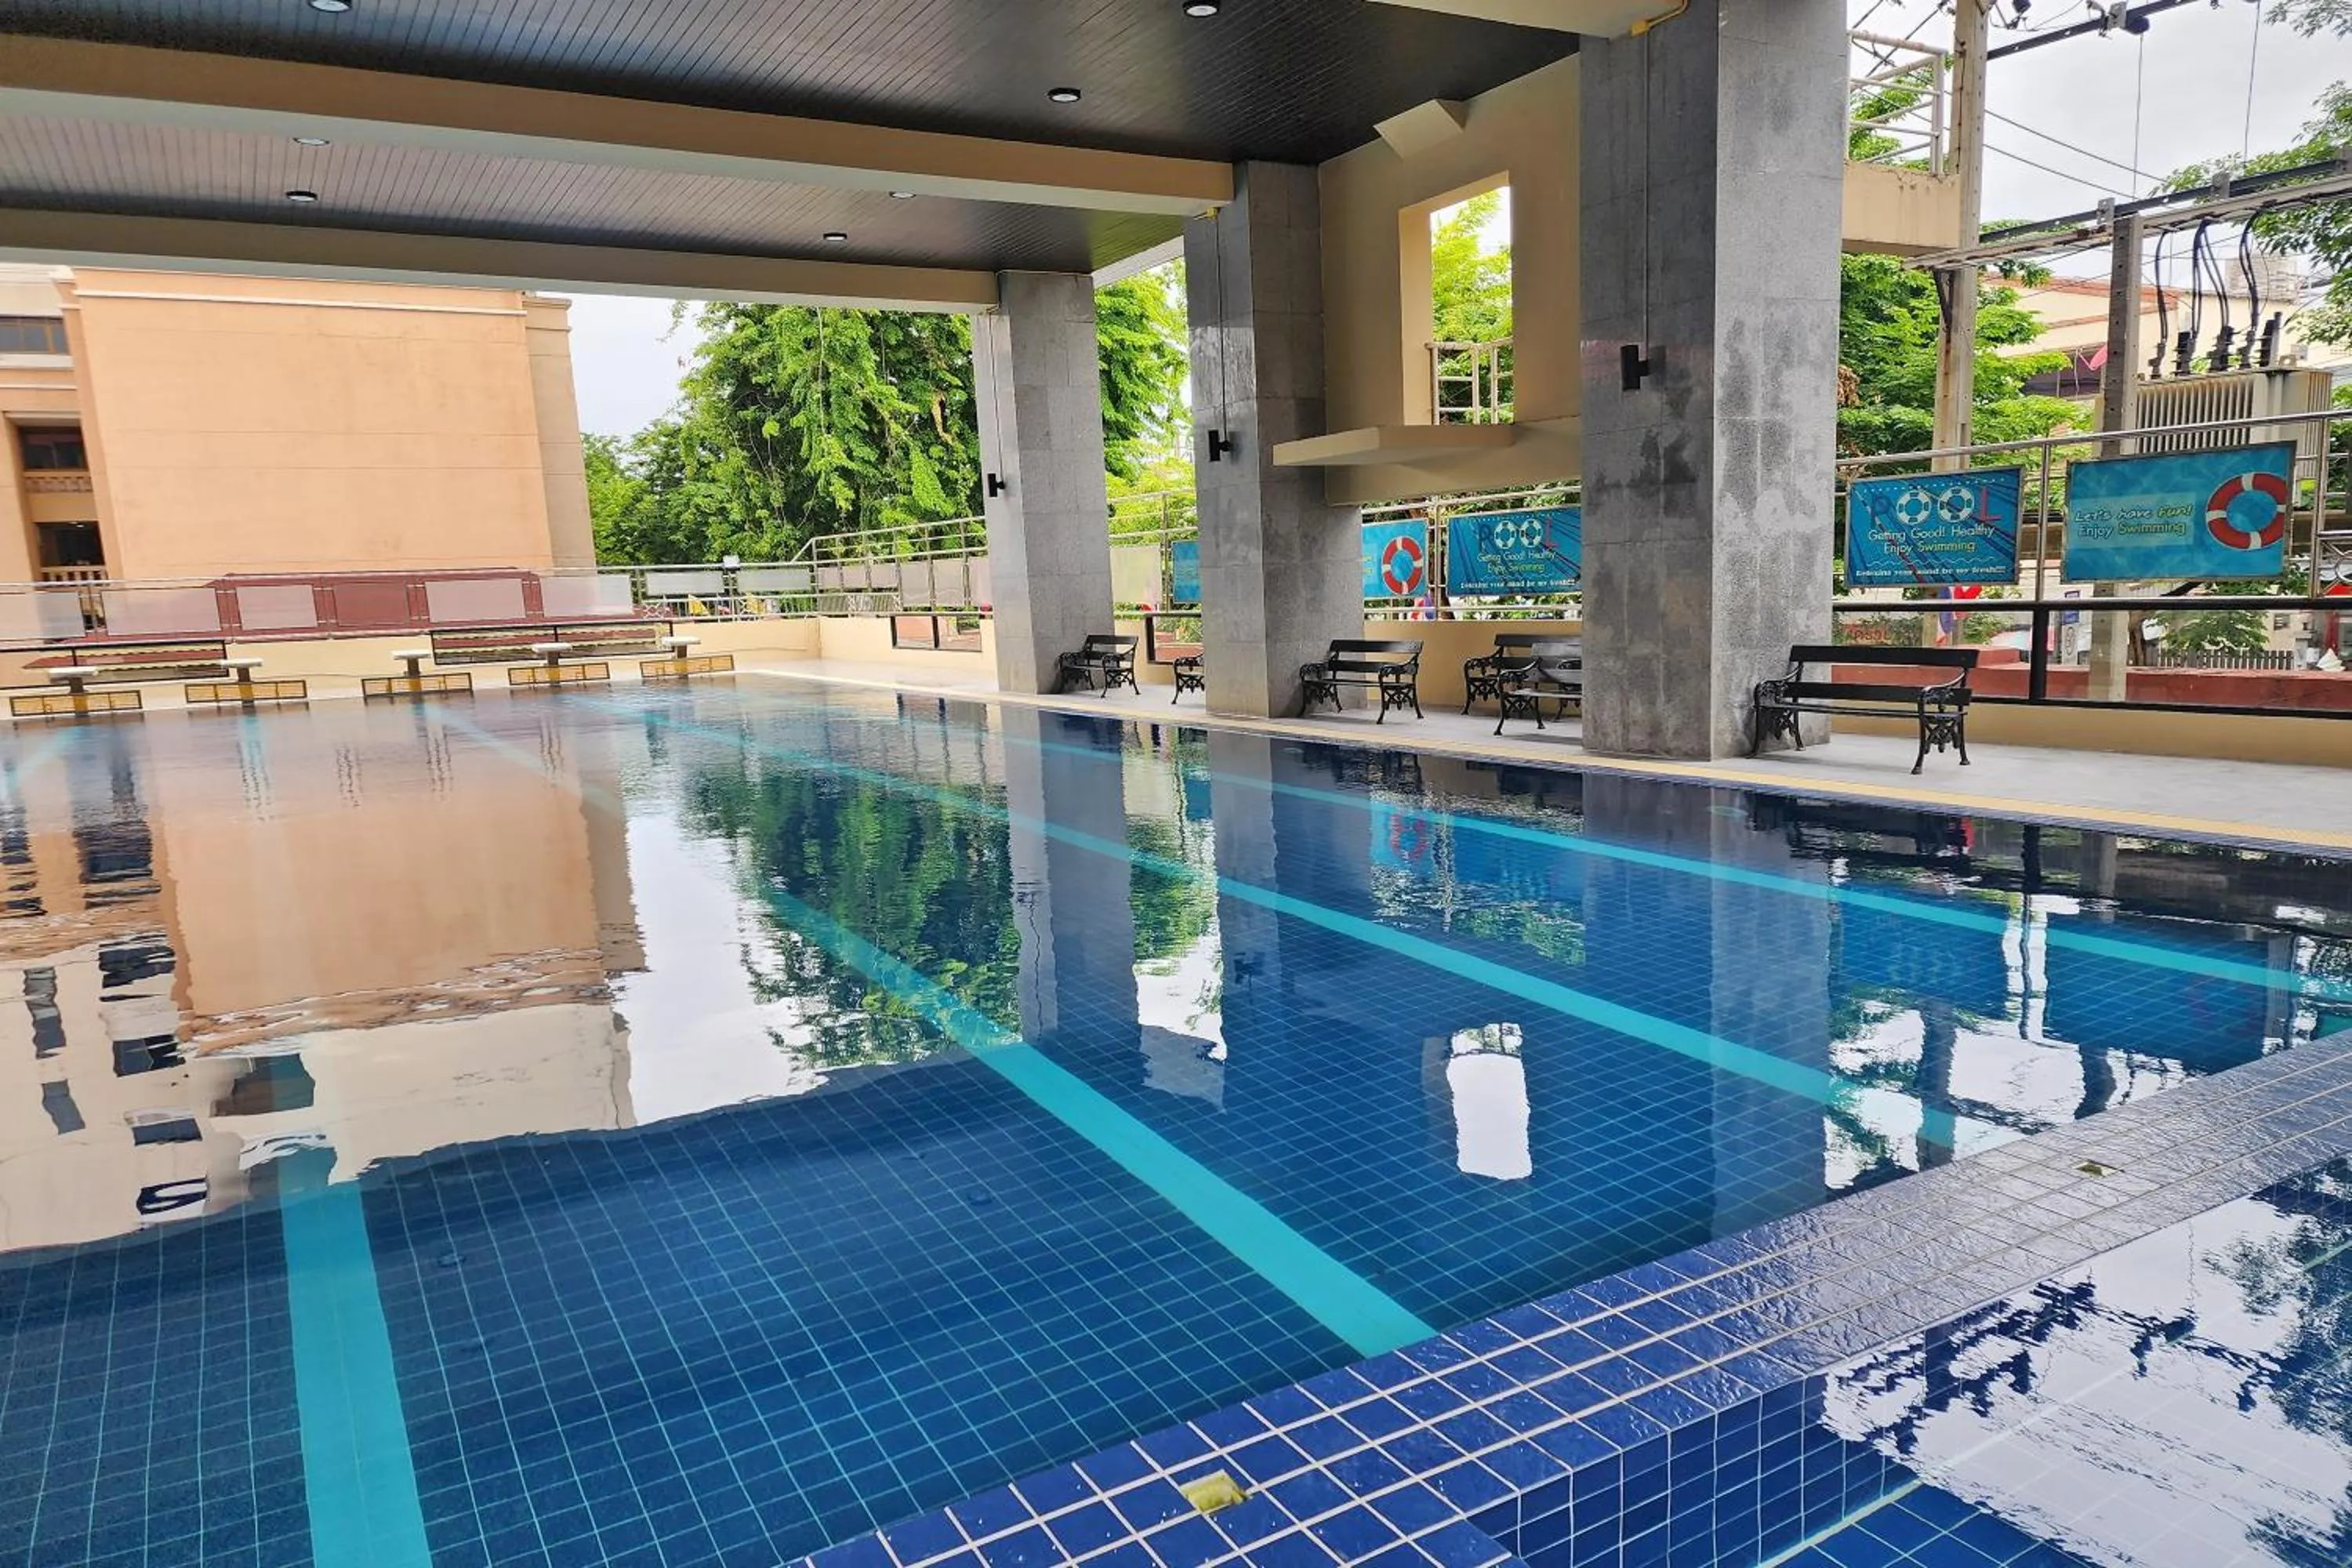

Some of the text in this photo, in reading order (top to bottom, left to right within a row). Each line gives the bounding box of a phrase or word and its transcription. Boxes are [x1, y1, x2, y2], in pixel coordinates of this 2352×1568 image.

[2074, 510, 2112, 523] Let's
[2116, 507, 2152, 521] have
[1911, 524, 1946, 539] Good!
[1951, 523, 1995, 539] Healthy
[2078, 522, 2187, 539] Enjoy Swimming
[1884, 540, 1976, 556] Enjoy Swimming
